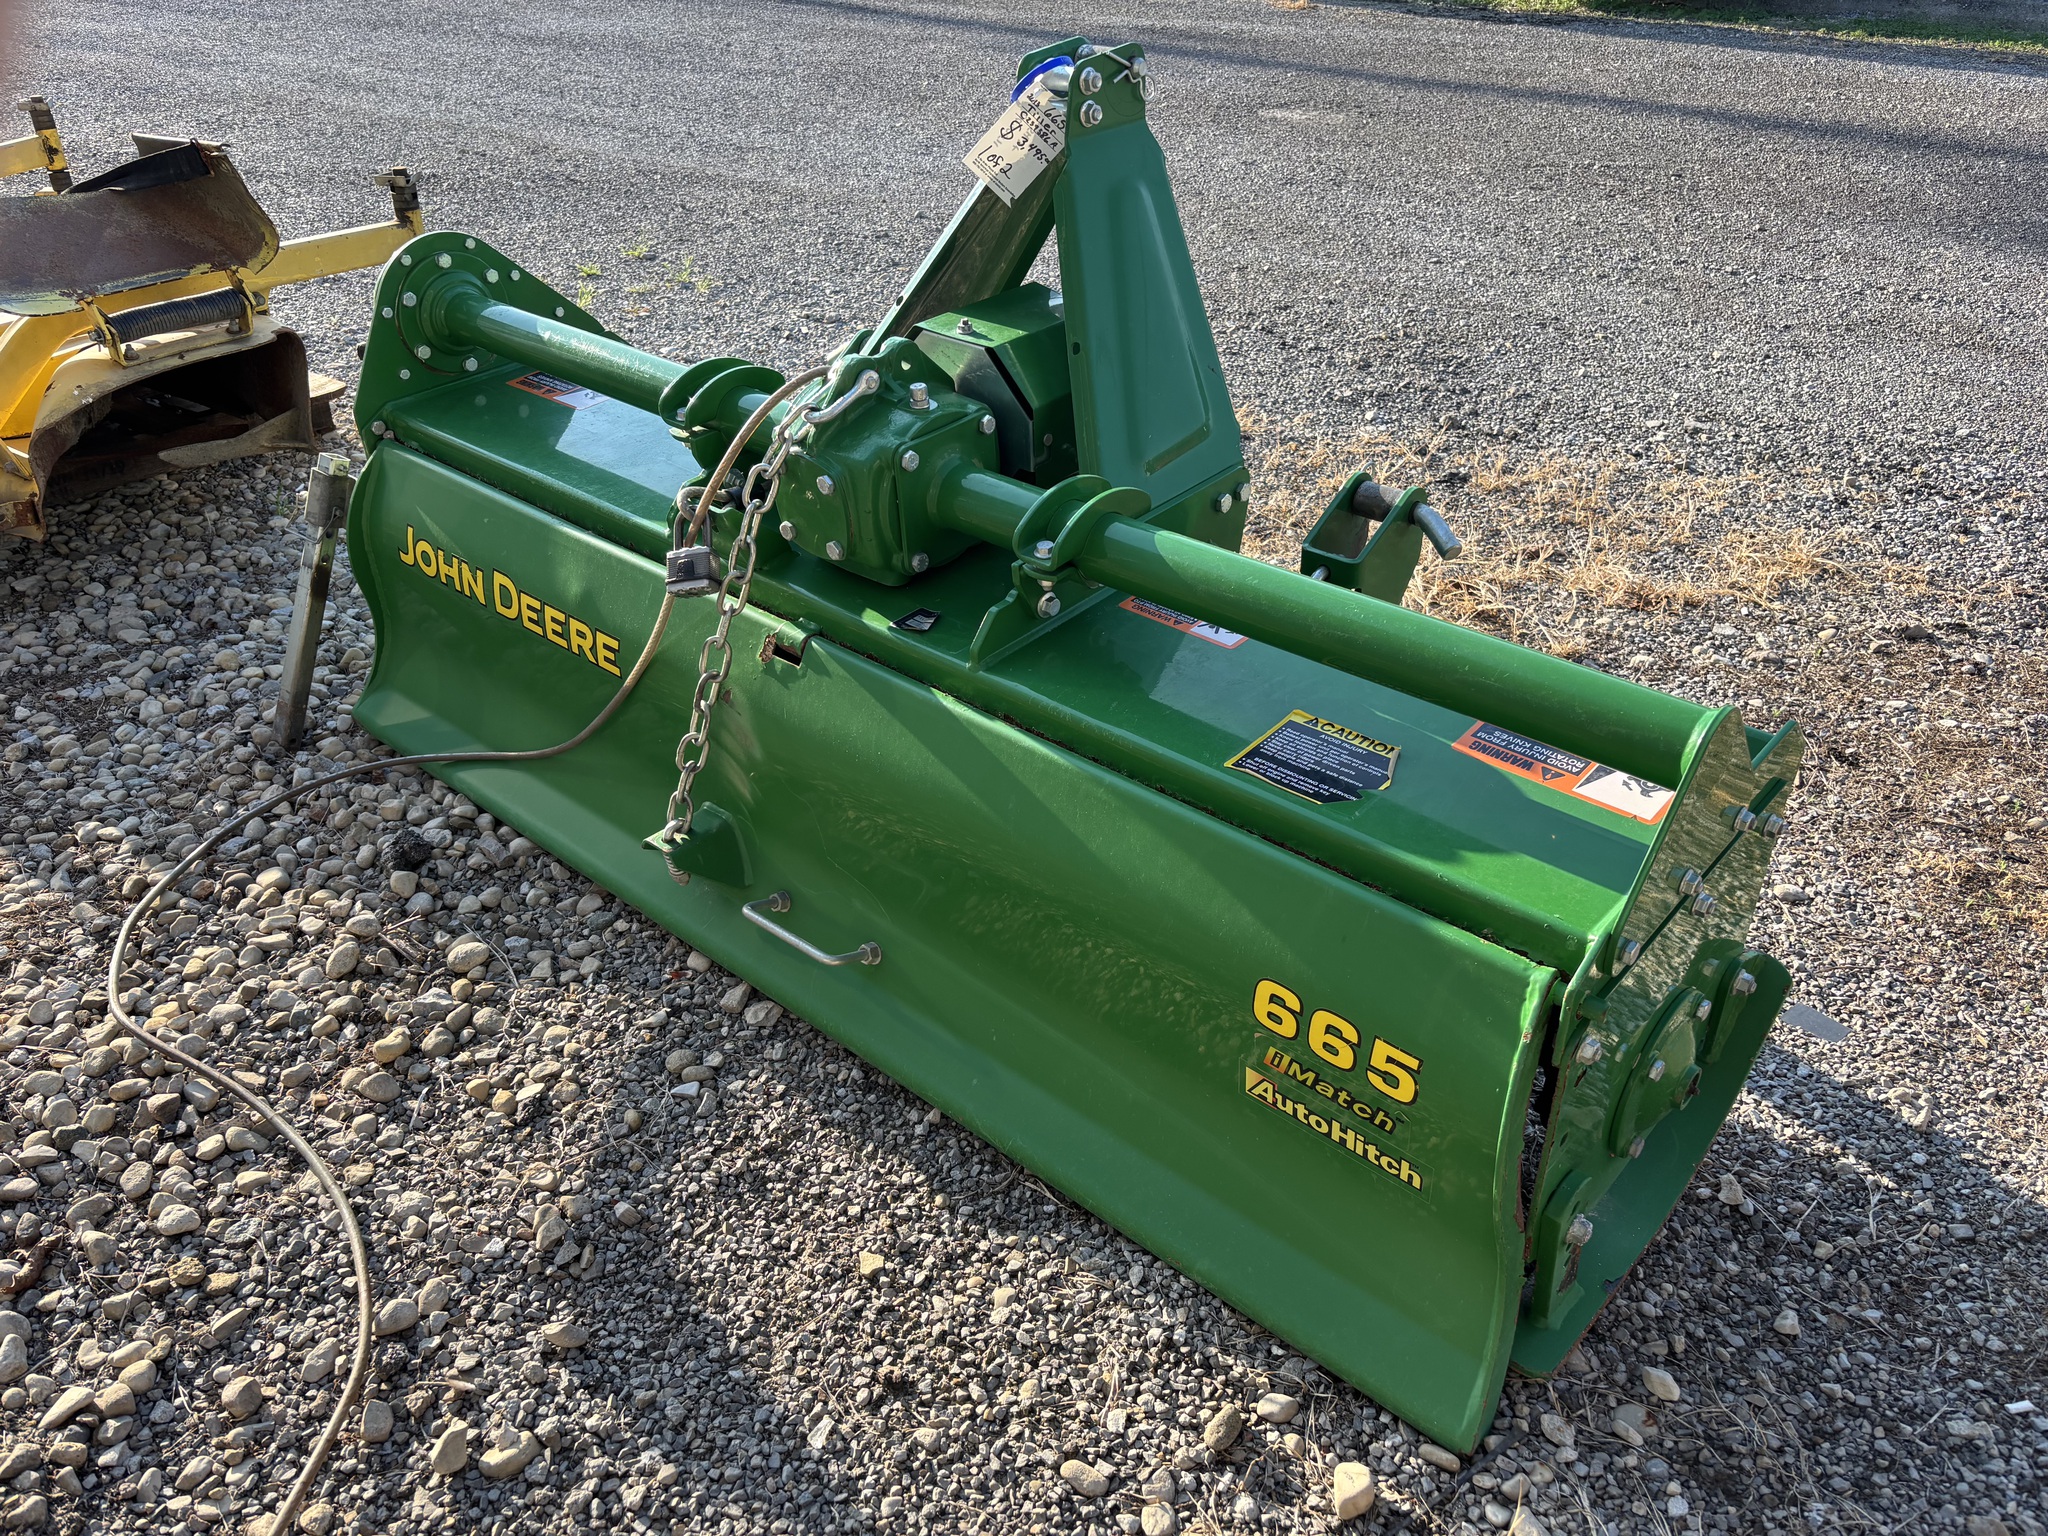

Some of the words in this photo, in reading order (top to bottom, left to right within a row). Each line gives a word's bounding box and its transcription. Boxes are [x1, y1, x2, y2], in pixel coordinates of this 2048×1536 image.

[1027, 104, 1057, 137] Tiller
[1044, 108, 1066, 129] 665
[1000, 120, 1021, 140] $
[987, 153, 1002, 169] of
[1000, 163, 1013, 180] 2
[398, 523, 486, 608] JOHN
[493, 567, 622, 679] DEERE
[1131, 604, 1171, 622] WARNING
[1296, 745, 1316, 755] shields
[1319, 735, 1341, 744] AVOID
[1341, 742, 1368, 754] INJURY
[1328, 745, 1349, 754] manual
[1477, 732, 1507, 746] FROM
[1493, 731, 1531, 748] KNIVES
[1267, 742, 1283, 750] Never
[1282, 749, 1298, 757] carry
[1298, 755, 1314, 763] riders
[1294, 740, 1316, 750] location
[1328, 753, 1351, 764] function
[1358, 766, 1381, 776] controls
[1469, 740, 1534, 771] WARNING
[1508, 744, 1546, 760] INJURY
[1533, 746, 1585, 768] ROTATING
[1275, 751, 1296, 760] people
[1339, 776, 1363, 787] distance
[1287, 760, 1310, 770] machine
[1303, 753, 1322, 761] power
[1322, 760, 1340, 768] driven
[1340, 767, 1355, 775] parts
[1547, 758, 1580, 772] AVOID
[1242, 762, 1259, 770] Lower
[1266, 772, 1281, 780] block
[1290, 782, 1314, 793] machine
[1254, 757, 1277, 768] BEFORE
[1277, 767, 1318, 785] DISMOUNTING
[1329, 788, 1359, 801] SERVICIN
[1267, 768, 1286, 777] engine
[1298, 781, 1319, 791] remove
[1252, 977, 1424, 1106] 665
[1263, 1046, 1397, 1135] iMatch
[1245, 1066, 1424, 1191] AutoHitch
